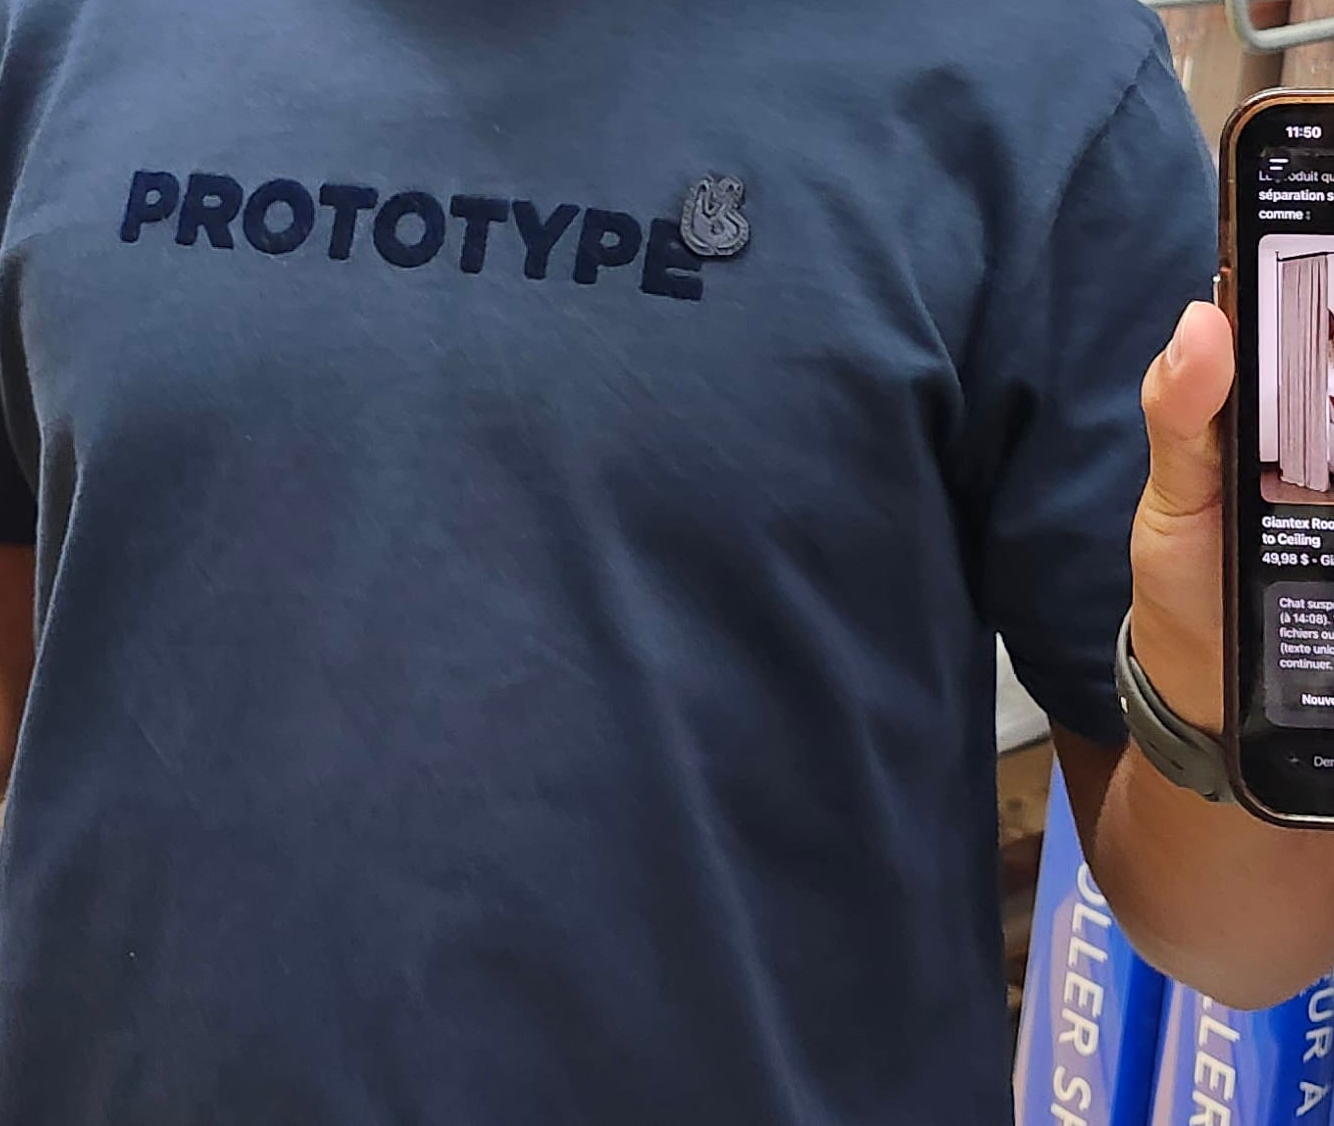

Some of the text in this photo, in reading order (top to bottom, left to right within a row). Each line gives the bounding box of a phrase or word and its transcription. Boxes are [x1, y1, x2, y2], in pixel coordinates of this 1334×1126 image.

[1285, 125, 1322, 139] 11:50
[1258, 188, 1325, 202] séparation
[1258, 209, 1304, 220] comme
[118, 168, 705, 302] PROTOTYPE
[1262, 516, 1310, 530] Giantex
[1262, 533, 1322, 549] to Ceiling
[1262, 553, 1298, 566] 49,98
[1300, 553, 1309, 566] $
[1279, 597, 1305, 609] Chat
[1279, 627, 1319, 640] fichiers
[1279, 657, 1333, 670] continuer.
